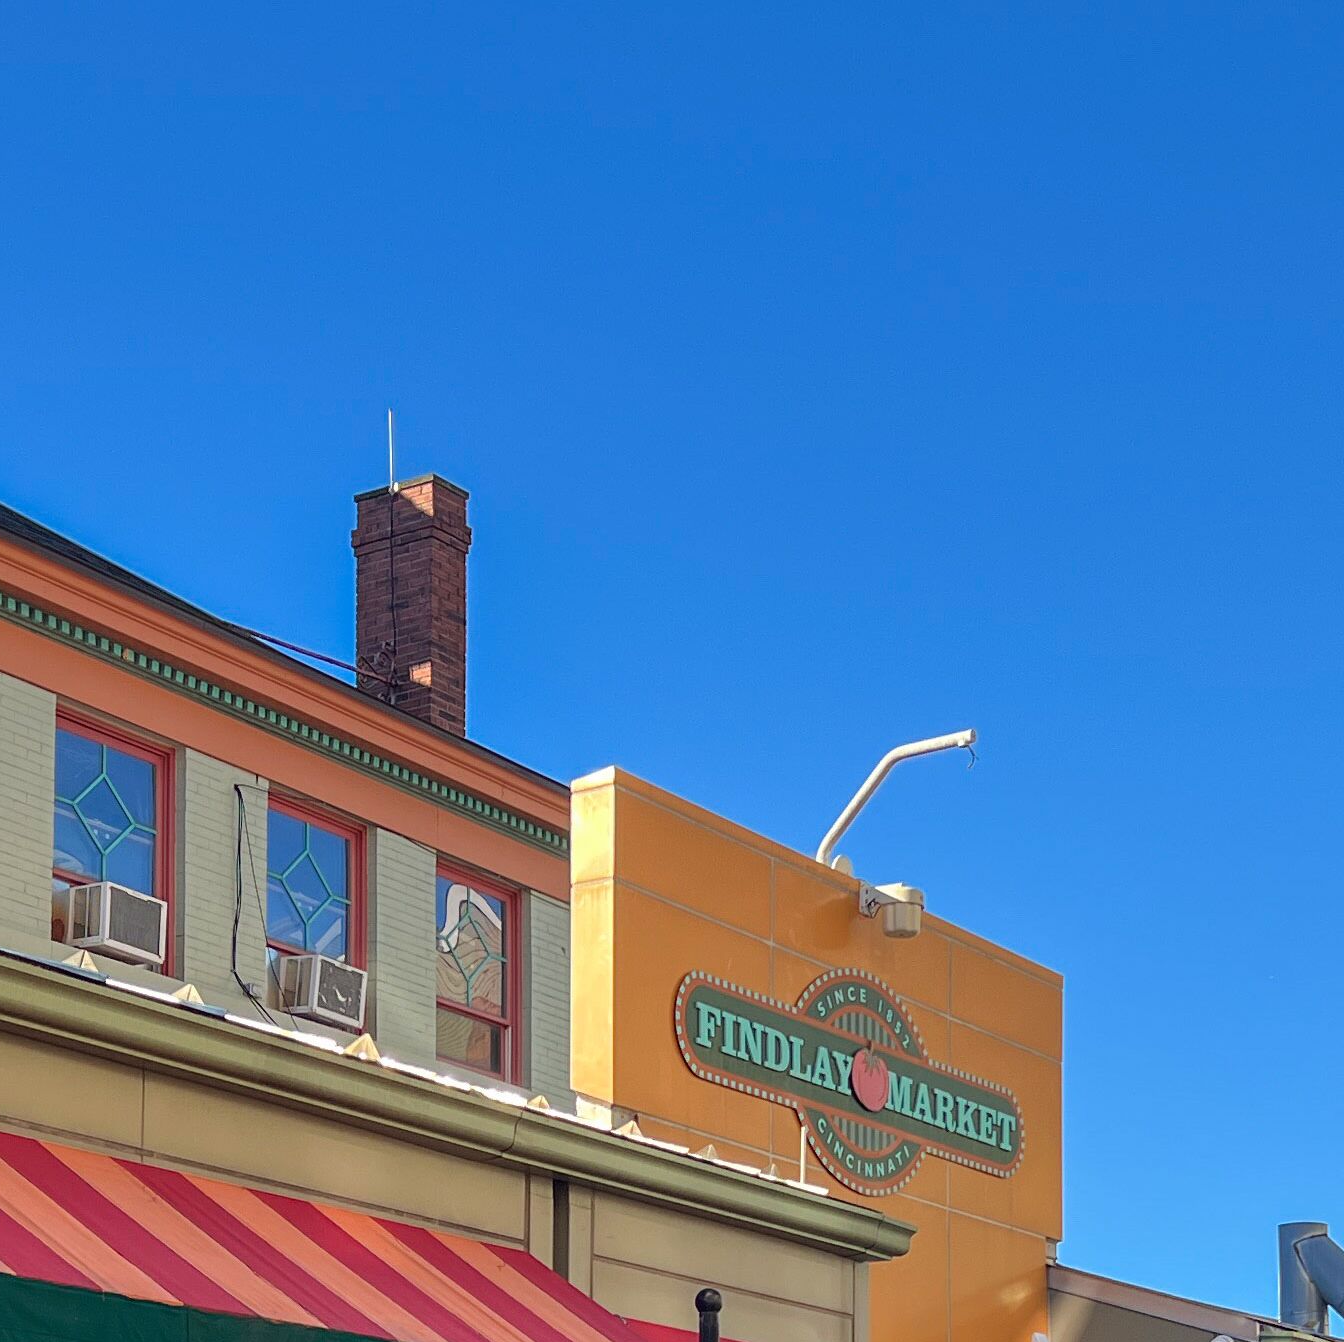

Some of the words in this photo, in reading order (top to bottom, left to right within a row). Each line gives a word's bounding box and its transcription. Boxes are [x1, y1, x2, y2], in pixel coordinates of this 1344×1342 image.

[816, 986, 867, 1018] SINCE
[878, 1000, 910, 1049] 1852
[694, 1001, 854, 1097] FINDLAY
[885, 1070, 1017, 1151] MARKET
[816, 1118, 910, 1178] CINCINNATI
